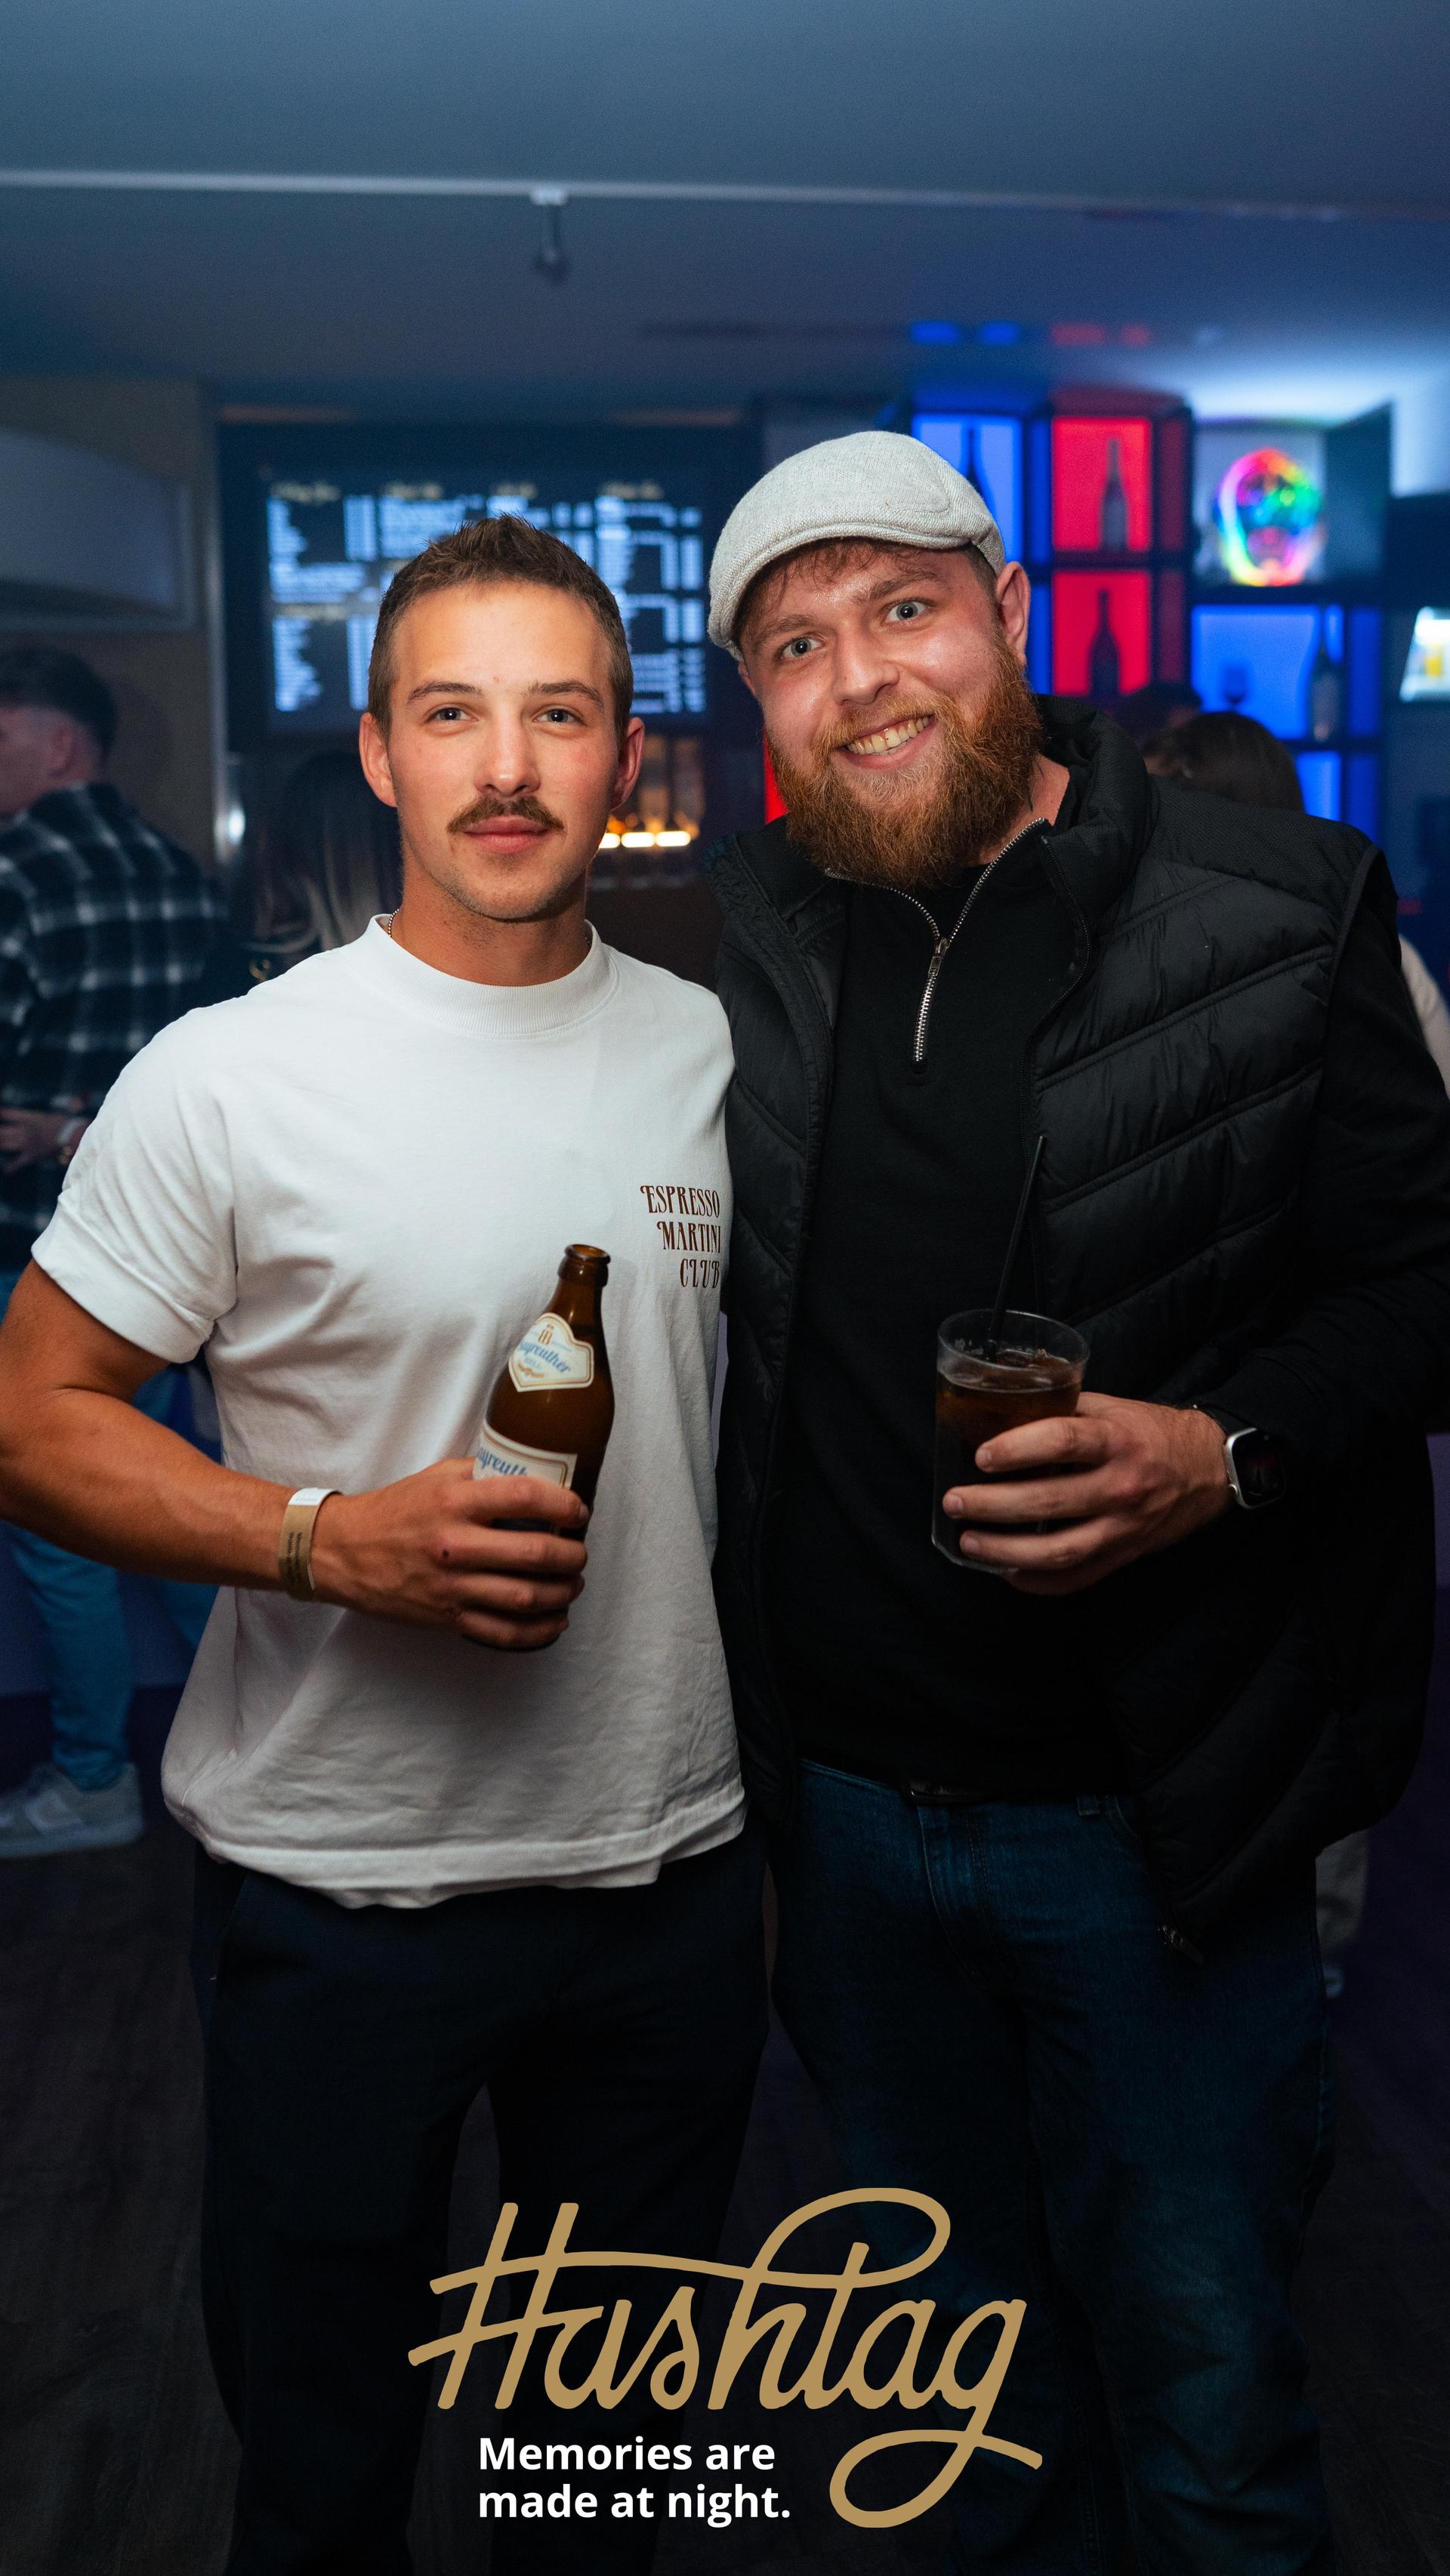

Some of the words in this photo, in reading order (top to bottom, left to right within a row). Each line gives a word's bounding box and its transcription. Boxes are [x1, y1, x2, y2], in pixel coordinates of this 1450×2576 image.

[640, 1185, 720, 1219] ESPRESSO
[656, 1221, 721, 1253] MARTINI
[680, 1258, 720, 1289] CLUB
